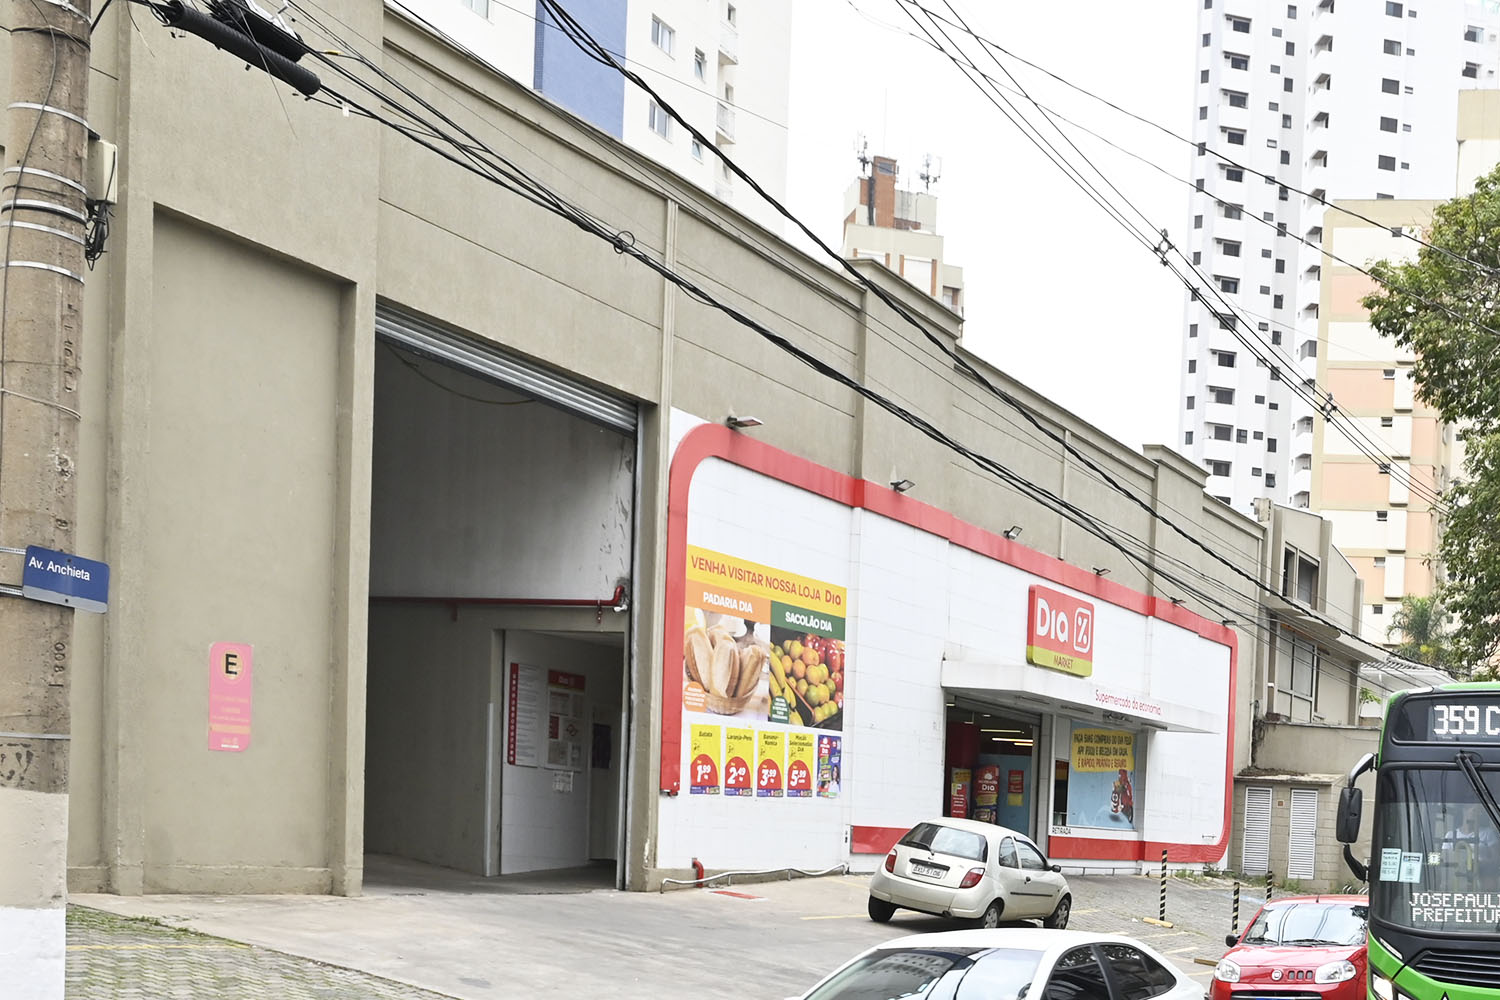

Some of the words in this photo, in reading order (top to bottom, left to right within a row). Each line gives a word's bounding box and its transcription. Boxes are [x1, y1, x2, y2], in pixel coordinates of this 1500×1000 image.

[28, 556, 44, 570] Av.
[46, 560, 91, 581] Anchieta
[691, 555, 727, 577] VENHA
[728, 565, 763, 586] VISITAR
[765, 575, 797, 595] NOSSA
[798, 585, 821, 601] LOJA
[703, 592, 738, 610] PADARIA
[739, 600, 753, 614] DIA
[785, 611, 820, 629] SACOLÃO
[820, 620, 833, 632] DIA
[1036, 598, 1069, 643] Dia
[225, 653, 238, 675] E
[1054, 655, 1074, 670] MARKET
[1096, 689, 1131, 708] Supermercado
[1132, 697, 1139, 710] da
[1433, 705, 1479, 735] 359
